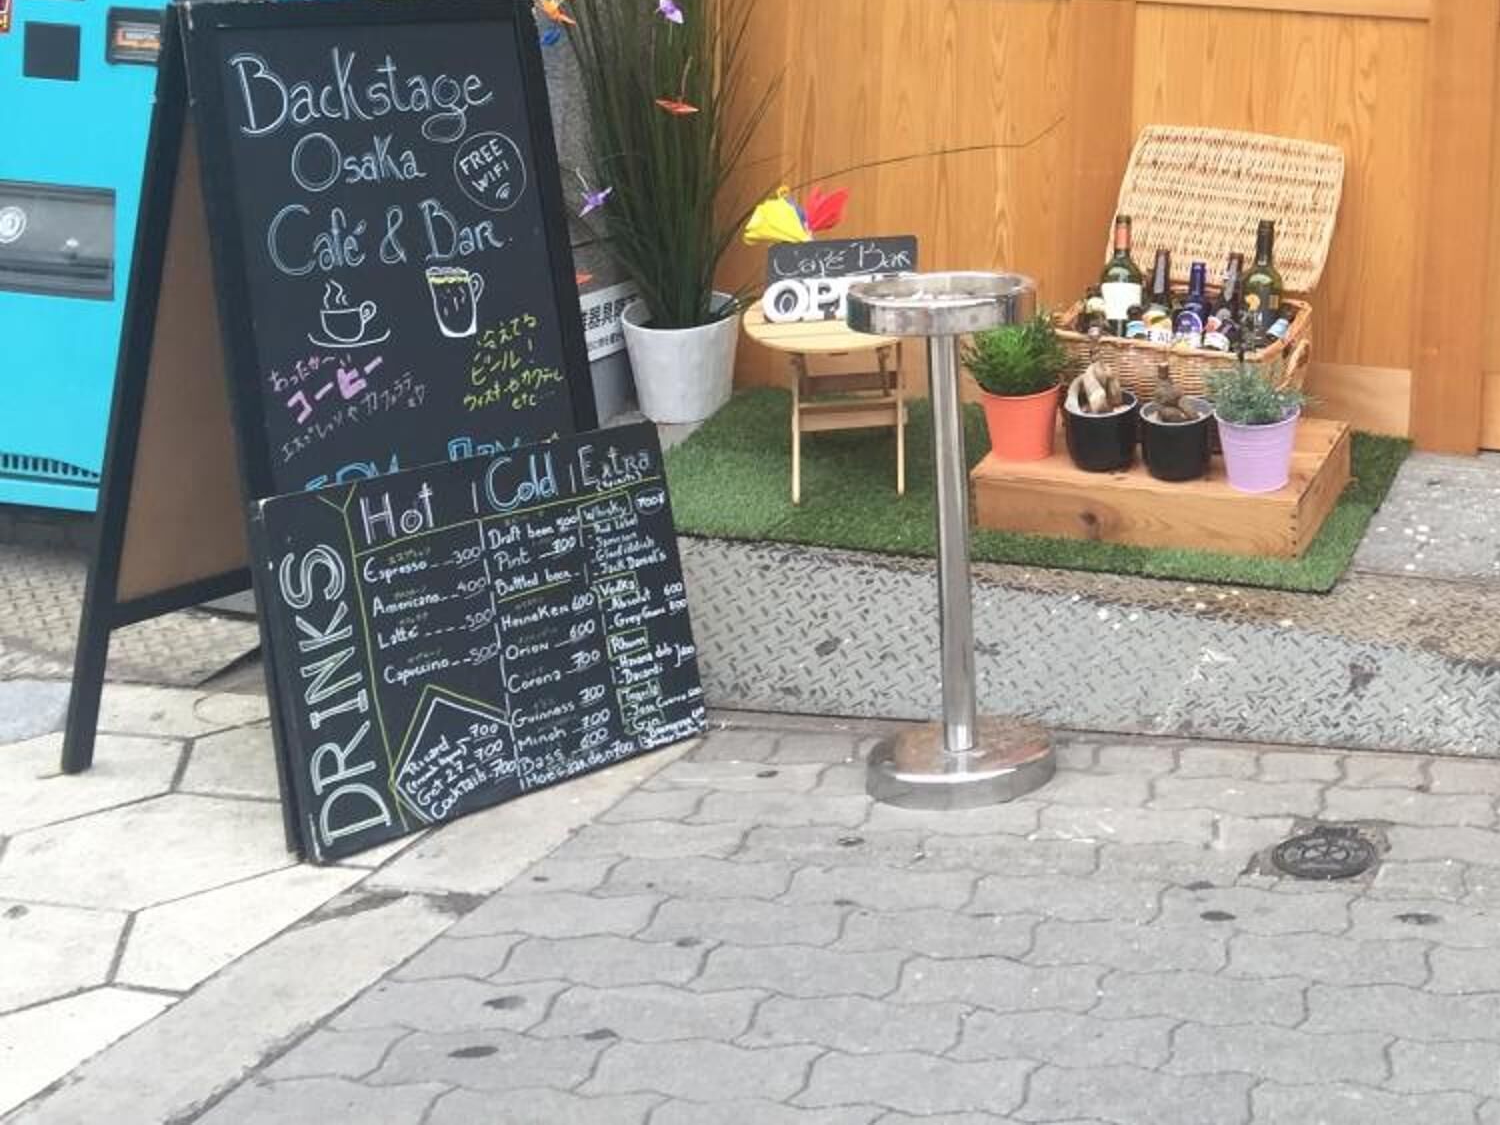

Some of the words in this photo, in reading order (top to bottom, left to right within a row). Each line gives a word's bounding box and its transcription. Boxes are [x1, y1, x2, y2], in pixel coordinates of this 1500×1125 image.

[229, 47, 494, 143] Backstage
[291, 131, 428, 193] Osaka
[460, 138, 503, 176] FREE
[379, 206, 408, 265] &
[485, 450, 559, 512] Cold
[359, 481, 434, 545] Hot
[487, 524, 522, 550] Draft
[363, 556, 428, 585] Espresso
[452, 546, 482, 566] 300
[493, 546, 534, 573] Pint
[372, 593, 442, 618] Americano
[456, 576, 489, 593] 400
[571, 592, 596, 612] 600
[464, 608, 495, 629] 500
[569, 618, 596, 639] 600
[279, 543, 392, 847] DRINKS
[508, 669, 562, 694] Corona
[467, 722, 500, 739] 700
[511, 700, 576, 728] Guinness
[472, 738, 504, 762] 700
